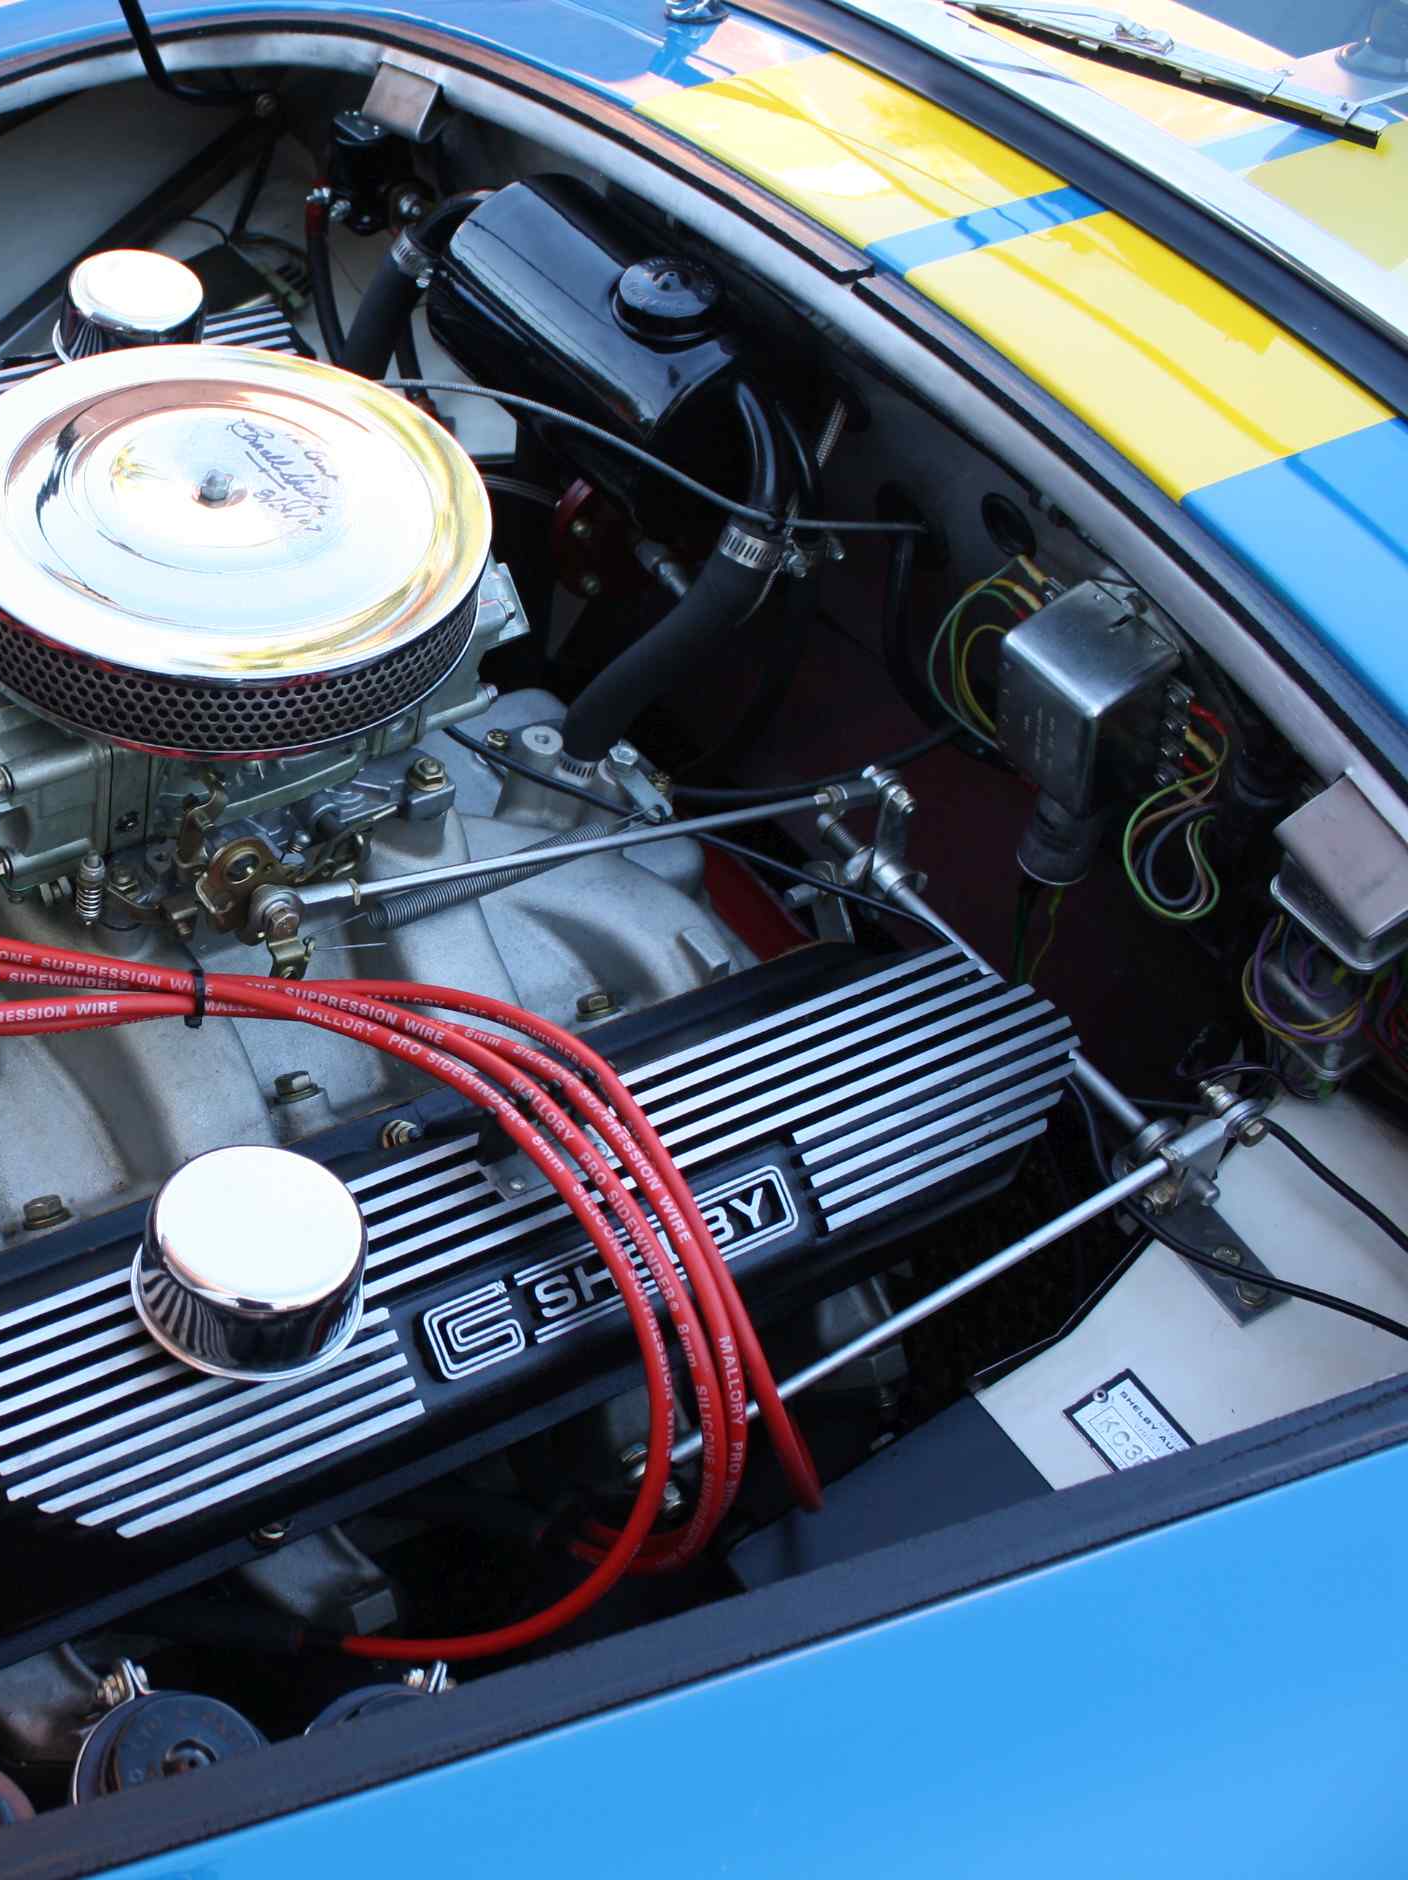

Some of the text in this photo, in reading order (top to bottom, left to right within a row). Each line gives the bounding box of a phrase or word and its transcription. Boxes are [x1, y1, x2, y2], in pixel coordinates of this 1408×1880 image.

[40, 957, 162, 986] SUPPRESSION
[169, 976, 215, 996] WIE
[75, 1000, 119, 1016] WIRE
[284, 986, 447, 1045] SUPPRESSION WIRE
[463, 1027, 502, 1048] 8mm
[511, 1043, 580, 1090] SILICONE
[296, 1005, 379, 1037] MALLORY
[388, 1033, 422, 1055] PRO
[531, 1135, 567, 1174] 8mm
[572, 1182, 628, 1263] SILICONE
[577, 1088, 663, 1192] SUPPRESSION
[658, 1194, 693, 1245] WIRE
[510, 1077, 576, 1142] MALLORY
[578, 1151, 609, 1186] PRO
[676, 1322, 697, 1368] 8mm
[695, 1384, 716, 1465] SILICONE
[718, 1334, 745, 1426] MALLORY
[1119, 1390, 1159, 1431] SHELBY
[727, 1440, 744, 1474] PRO
